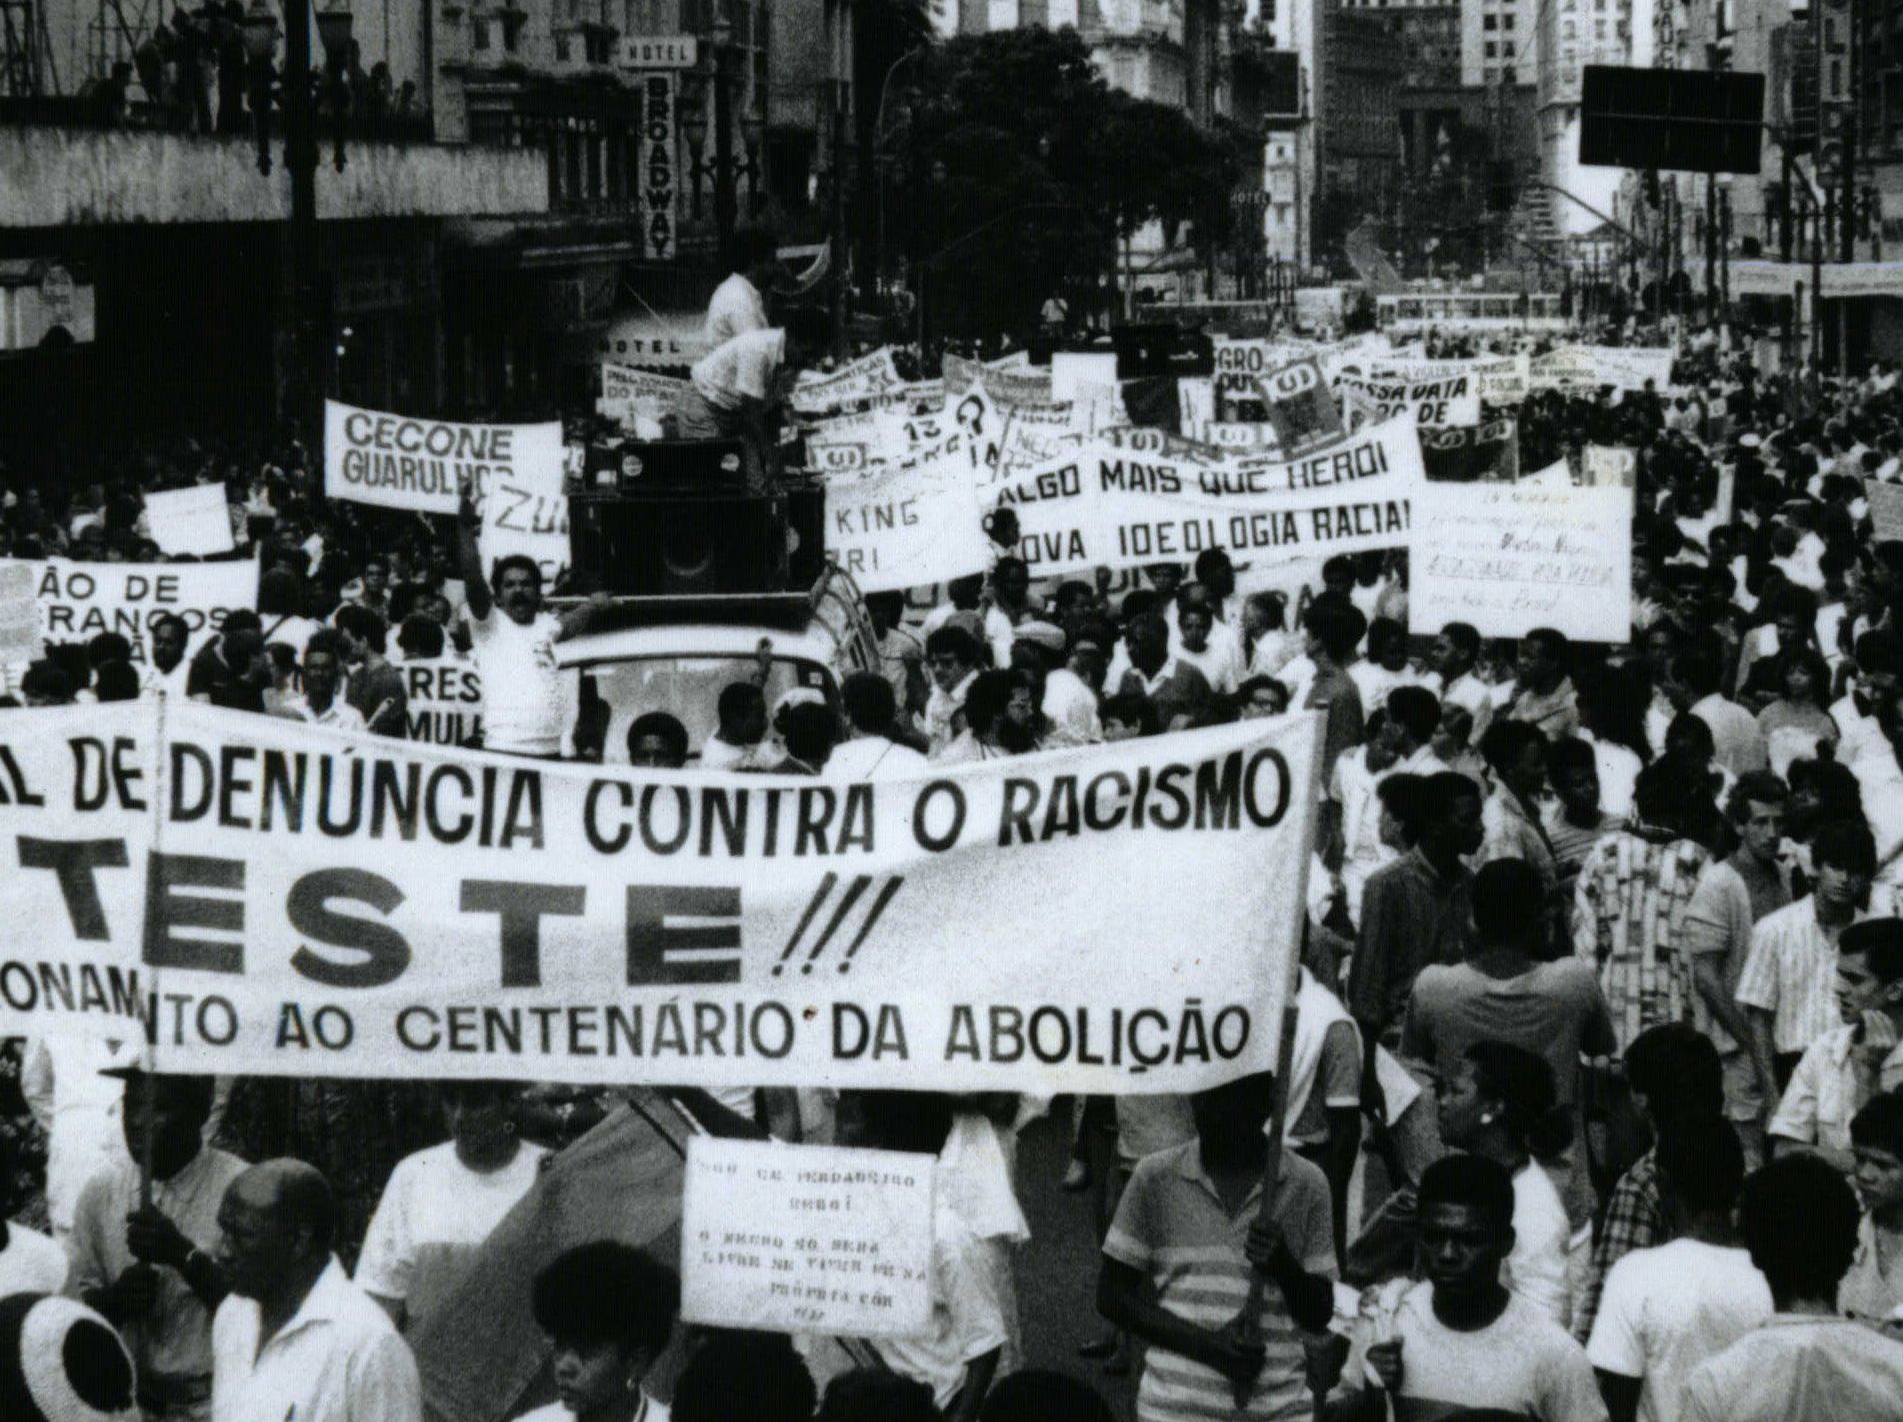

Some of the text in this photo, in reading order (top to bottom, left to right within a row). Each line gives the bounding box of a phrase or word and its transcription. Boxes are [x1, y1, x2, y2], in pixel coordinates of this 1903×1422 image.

[629, 45, 686, 60] HOTEL
[648, 78, 671, 255] BROADWAY
[345, 412, 514, 463] CECONE
[998, 463, 1082, 507] ALGO
[1099, 459, 1182, 495] MAIS
[835, 498, 921, 534] KING
[1118, 511, 1300, 557] IDEOLOGIA
[124, 573, 181, 602] DE
[67, 735, 149, 815] DE
[169, 737, 545, 851] DENÚNCIA
[583, 783, 878, 859] CONTRA
[911, 777, 970, 853] O
[998, 745, 1290, 849] RACISMO
[274, 998, 355, 1054] AO
[395, 994, 796, 1060] CENTENÁRIO
[830, 1001, 911, 1064] DA
[944, 997, 1253, 1077] ABOLIÇÃO
